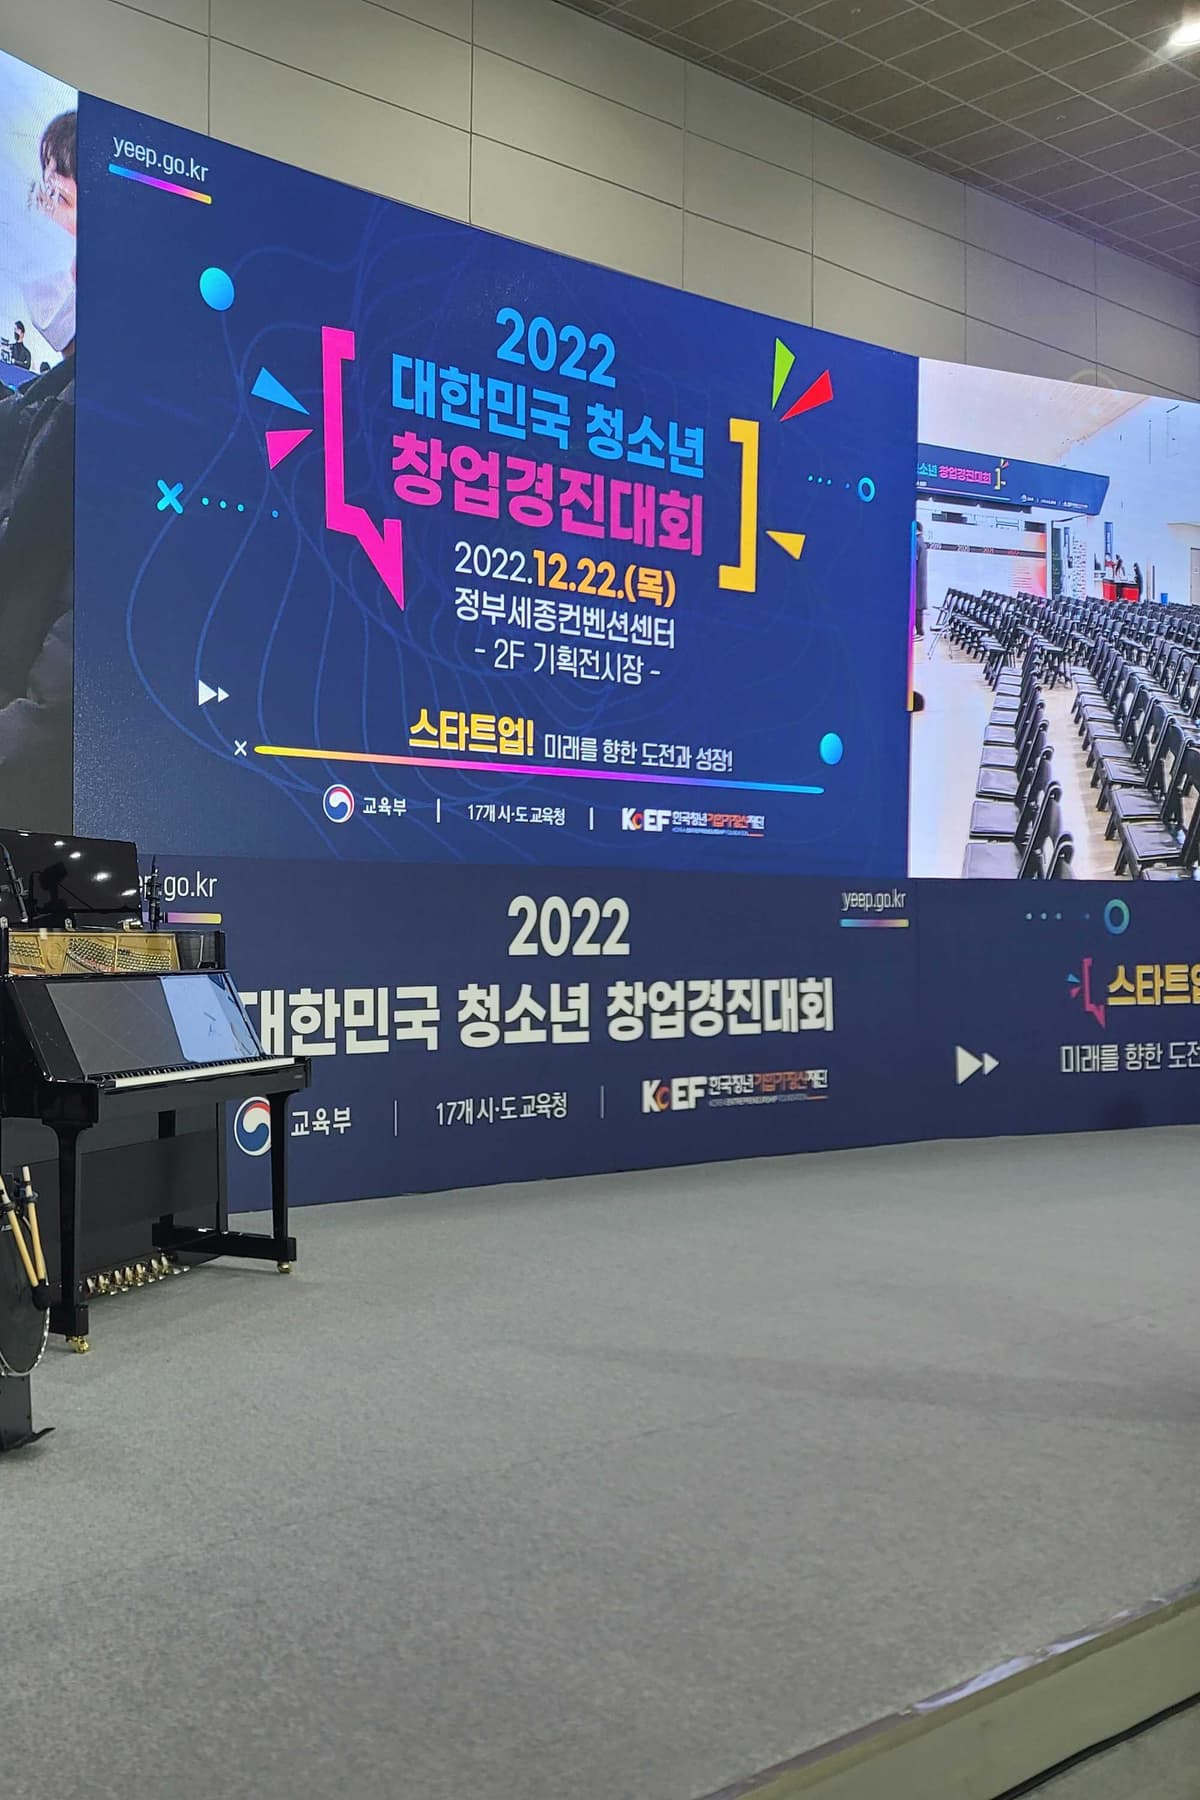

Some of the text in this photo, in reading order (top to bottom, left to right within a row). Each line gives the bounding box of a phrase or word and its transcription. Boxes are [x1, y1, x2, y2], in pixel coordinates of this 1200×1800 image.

[112, 136, 209, 182] yeep.go.kr
[495, 307, 616, 388] 2022
[391, 352, 705, 479] 대한민국 청소년
[391, 430, 703, 557] 창업경진대회
[455, 541, 676, 608] 2022.12.22.(목)
[454, 586, 676, 650] 정부세종컨벤션센터
[494, 638, 645, 686] 2F 기획전시장
[408, 708, 733, 772] 스타트업! 미래를 향한 도전과 성장!
[362, 796, 407, 817] 교육부
[467, 803, 496, 823] 17개
[529, 806, 566, 826] 교육청
[507, 895, 630, 957] 2022
[841, 888, 907, 912] yeep.go.kr
[456, 982, 590, 1048] 청소년
[606, 976, 834, 1042] 창업경진대회
[1060, 1043, 1120, 1073] 미래를
[1125, 1041, 1163, 1071] 향한
[290, 1106, 352, 1137] 교육부
[435, 1098, 475, 1126] 17개
[518, 1091, 568, 1119] 교육청
